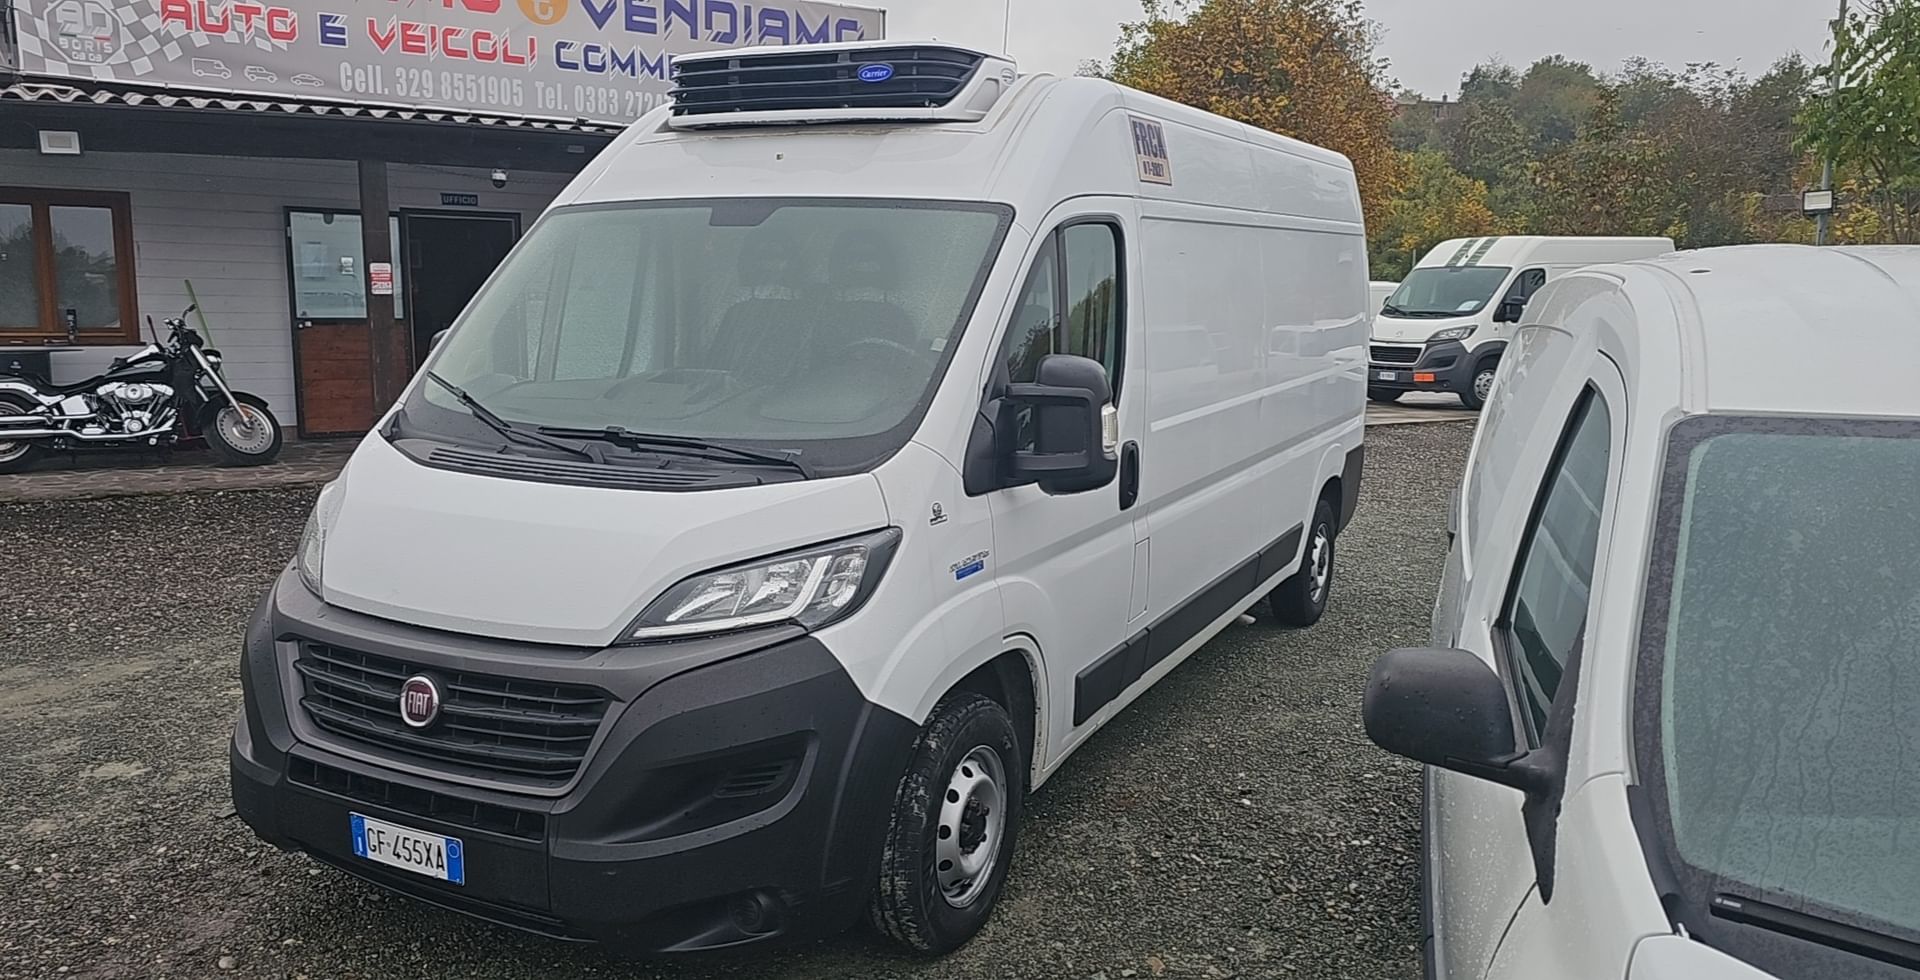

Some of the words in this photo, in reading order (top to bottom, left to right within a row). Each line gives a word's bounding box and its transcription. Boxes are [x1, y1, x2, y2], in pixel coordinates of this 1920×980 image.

[59, 37, 113, 54] BORIS
[160, 0, 298, 45] AUTO
[317, 12, 348, 48] E
[366, 14, 537, 72] VEICOLI
[861, 69, 888, 79] Carrier
[339, 62, 389, 95] Cell.
[395, 67, 433, 98] 329
[440, 71, 523, 107] 8551905
[535, 81, 568, 111] Tel.
[574, 85, 618, 116] 0383
[443, 194, 477, 205] UFFICIO
[407, 690, 430, 716] FIAT
